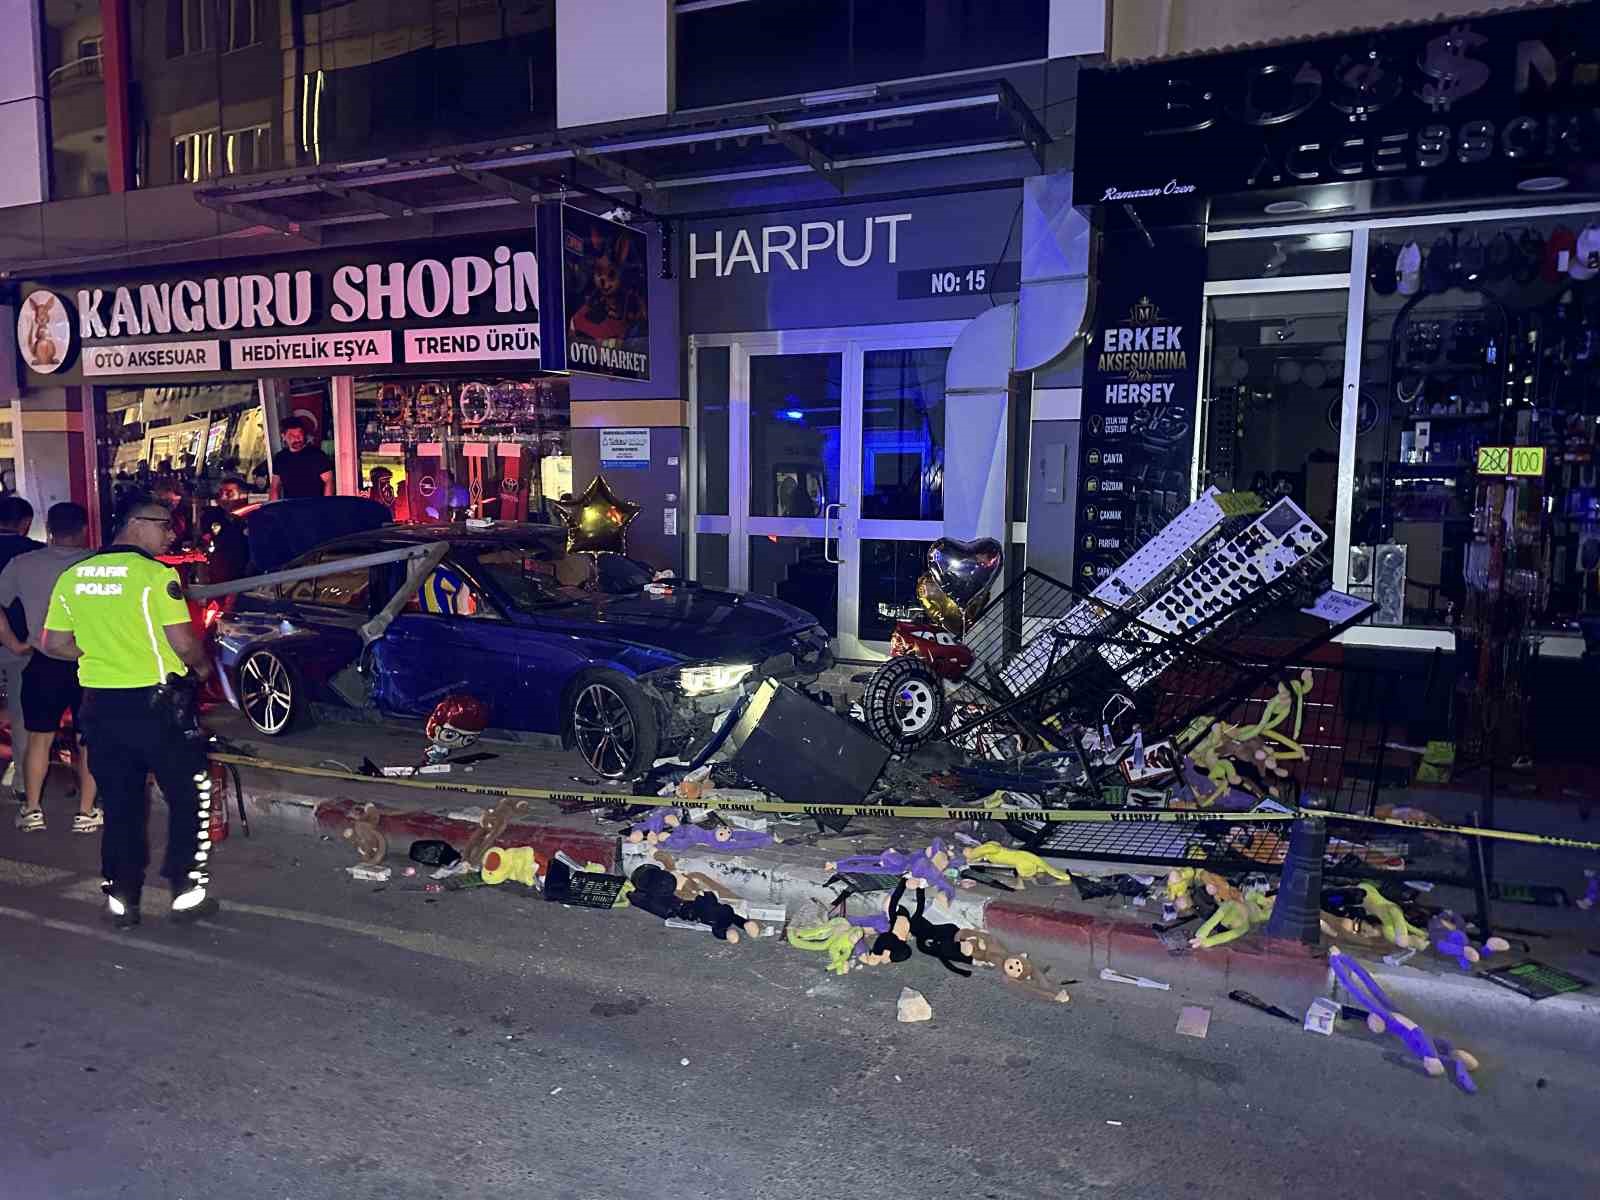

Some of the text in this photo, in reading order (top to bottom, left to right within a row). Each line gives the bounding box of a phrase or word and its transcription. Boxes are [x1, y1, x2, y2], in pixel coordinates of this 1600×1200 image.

[1100, 187, 1162, 202] Ramazan
[689, 213, 912, 279] HARPUT
[930, 270, 986, 294] NO: 15
[77, 270, 312, 339] KANGURU
[242, 337, 379, 362] HEDİYELİK EŞYA
[414, 334, 480, 355] TREND
[1104, 326, 1183, 352] ERKEK
[95, 348, 207, 369] OTO AKSESUAR
[570, 341, 648, 373] OTO MARKET
[1098, 351, 1187, 372] AKSESUARINA
[1105, 383, 1175, 407] HERŞEY
[1103, 453, 1123, 466] ÇANTA
[1515, 450, 1540, 472] 100
[1098, 538, 1120, 549] PARFÜM
